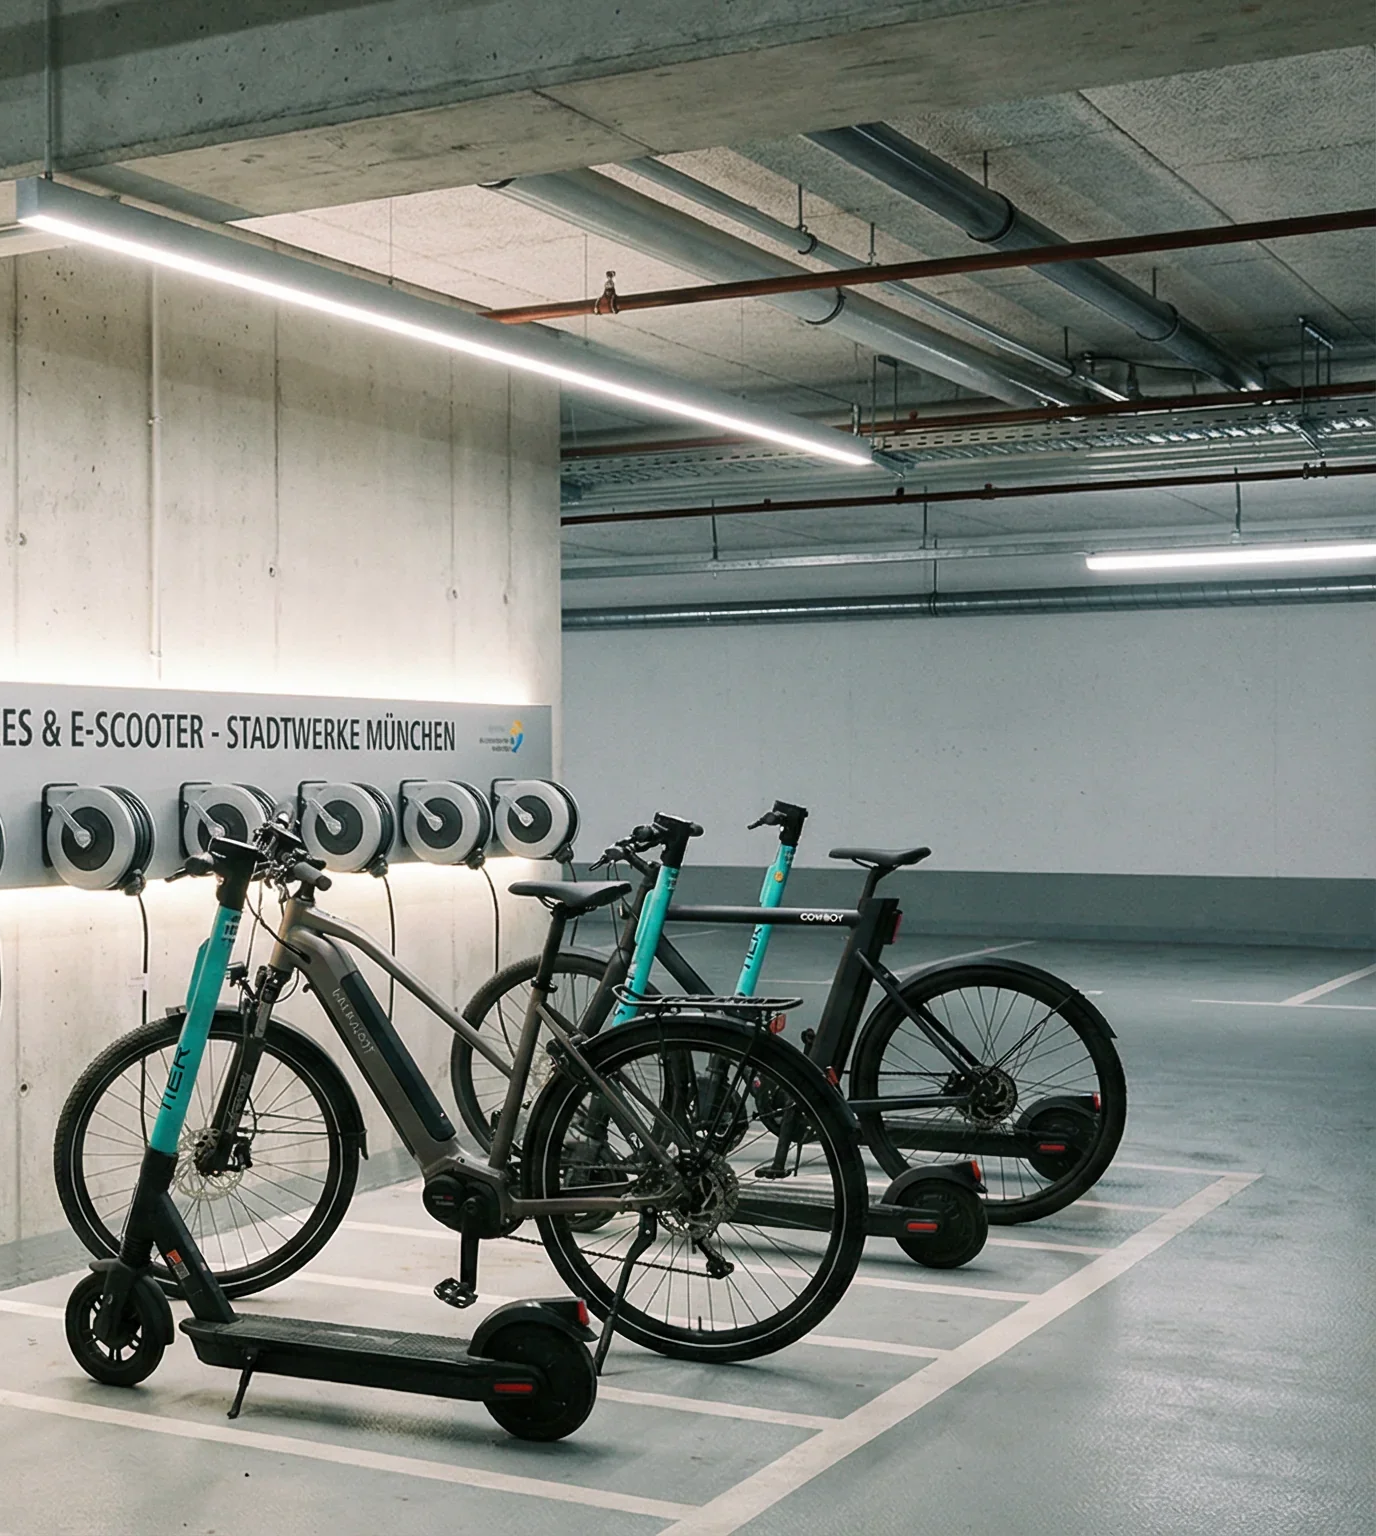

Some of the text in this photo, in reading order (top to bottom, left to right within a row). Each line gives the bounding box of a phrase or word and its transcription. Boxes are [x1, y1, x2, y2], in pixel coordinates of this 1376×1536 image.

[42, 709, 62, 747] &
[71, 710, 204, 749] E-SCOOTER
[227, 715, 360, 750] STADTWERKE
[366, 712, 455, 751] MÜNCHEN
